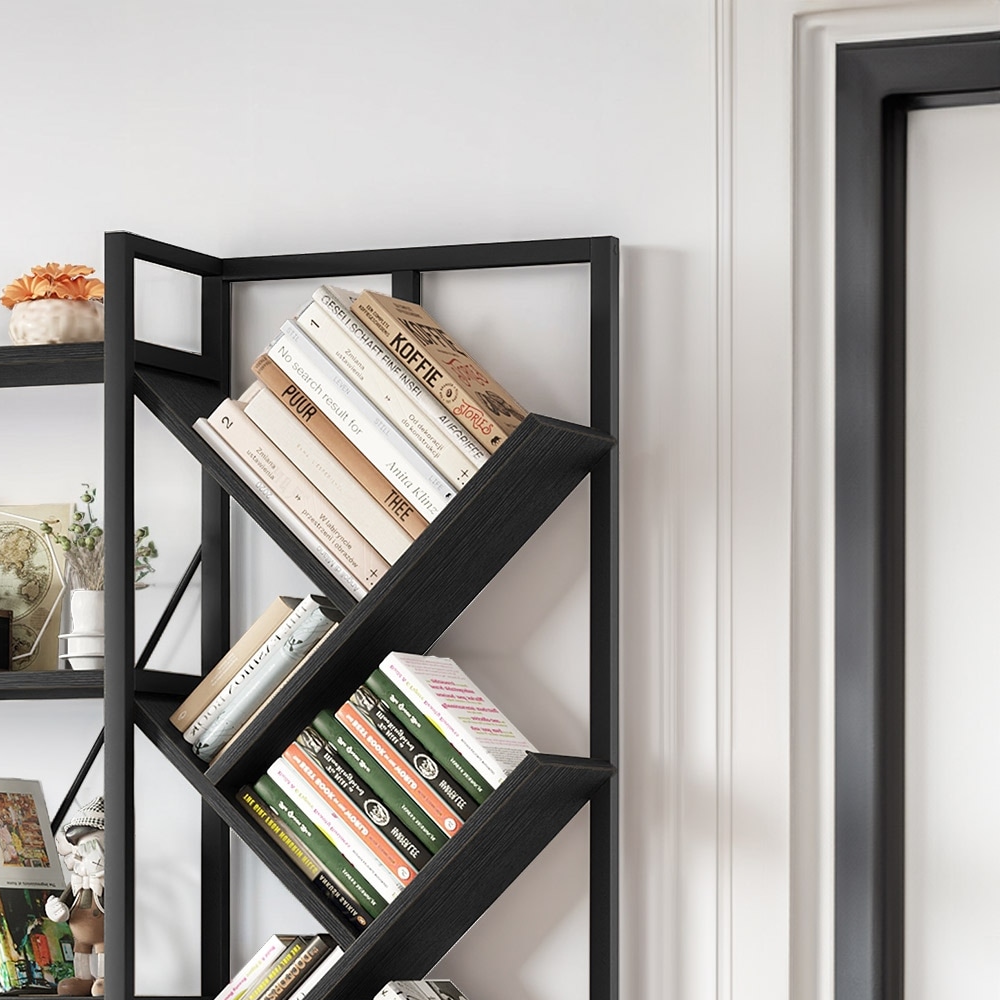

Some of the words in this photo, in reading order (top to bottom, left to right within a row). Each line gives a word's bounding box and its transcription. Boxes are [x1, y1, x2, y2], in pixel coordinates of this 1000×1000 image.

[334, 349, 365, 382] ustawienia
[343, 347, 366, 371] Zmiana
[386, 330, 444, 390] KOFFIE
[450, 395, 496, 442] STORIES
[276, 344, 296, 364] No
[290, 358, 326, 395] search
[320, 390, 351, 422] result
[346, 417, 365, 437] for
[384, 457, 416, 490] Anita
[407, 412, 420, 425] Od
[415, 422, 444, 452] dekoracji
[254, 445, 278, 470] Zmiana
[279, 382, 319, 423] PUUR
[380, 488, 415, 523] THEE
[400, 417, 411, 428] do
[407, 425, 441, 460] konstrukcji
[244, 448, 277, 481] ustawienia
[254, 479, 273, 500] 2020
[317, 512, 328, 523] W
[323, 519, 354, 551] labiryncie
